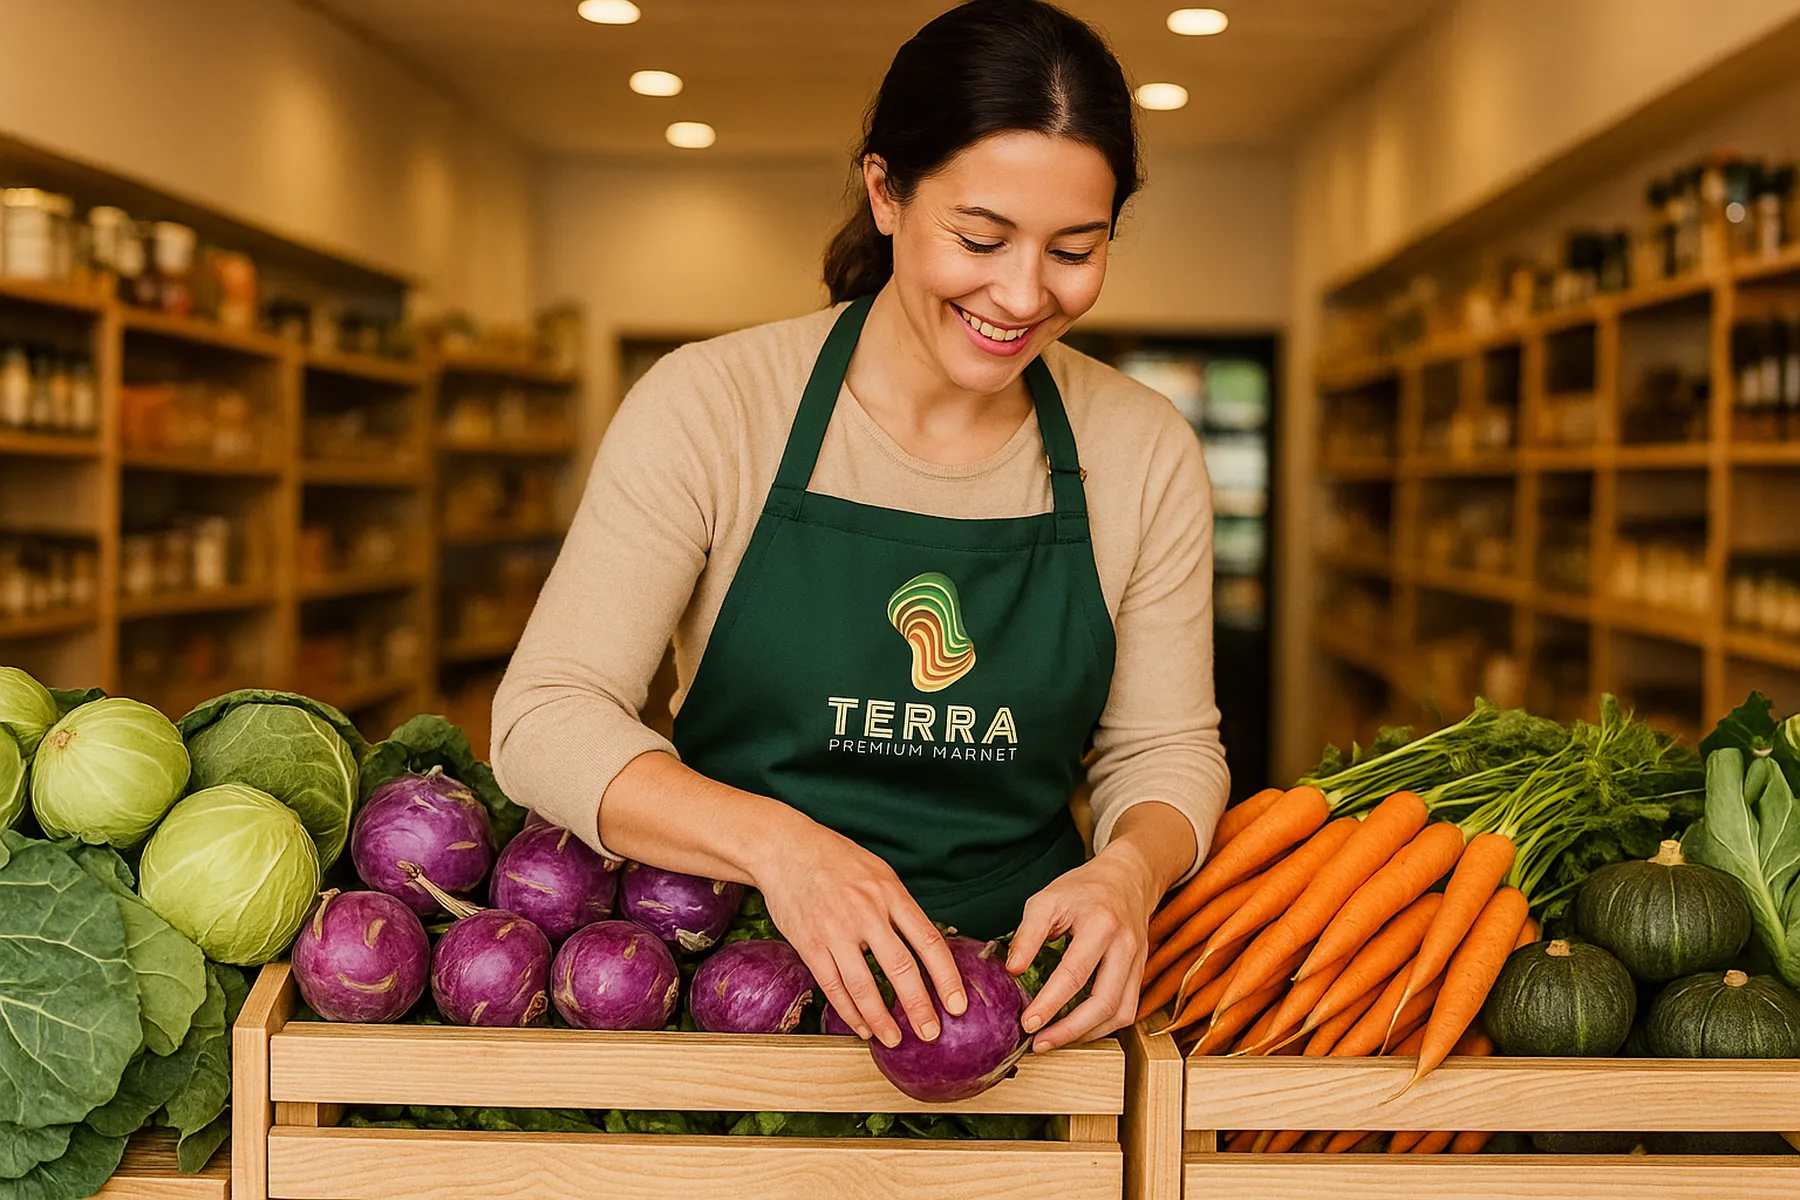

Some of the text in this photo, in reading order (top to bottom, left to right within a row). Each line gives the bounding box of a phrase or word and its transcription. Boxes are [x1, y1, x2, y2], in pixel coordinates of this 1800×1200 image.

[828, 697, 1018, 744] TERRA
[828, 739, 1017, 761] PREMIUM MARNET
